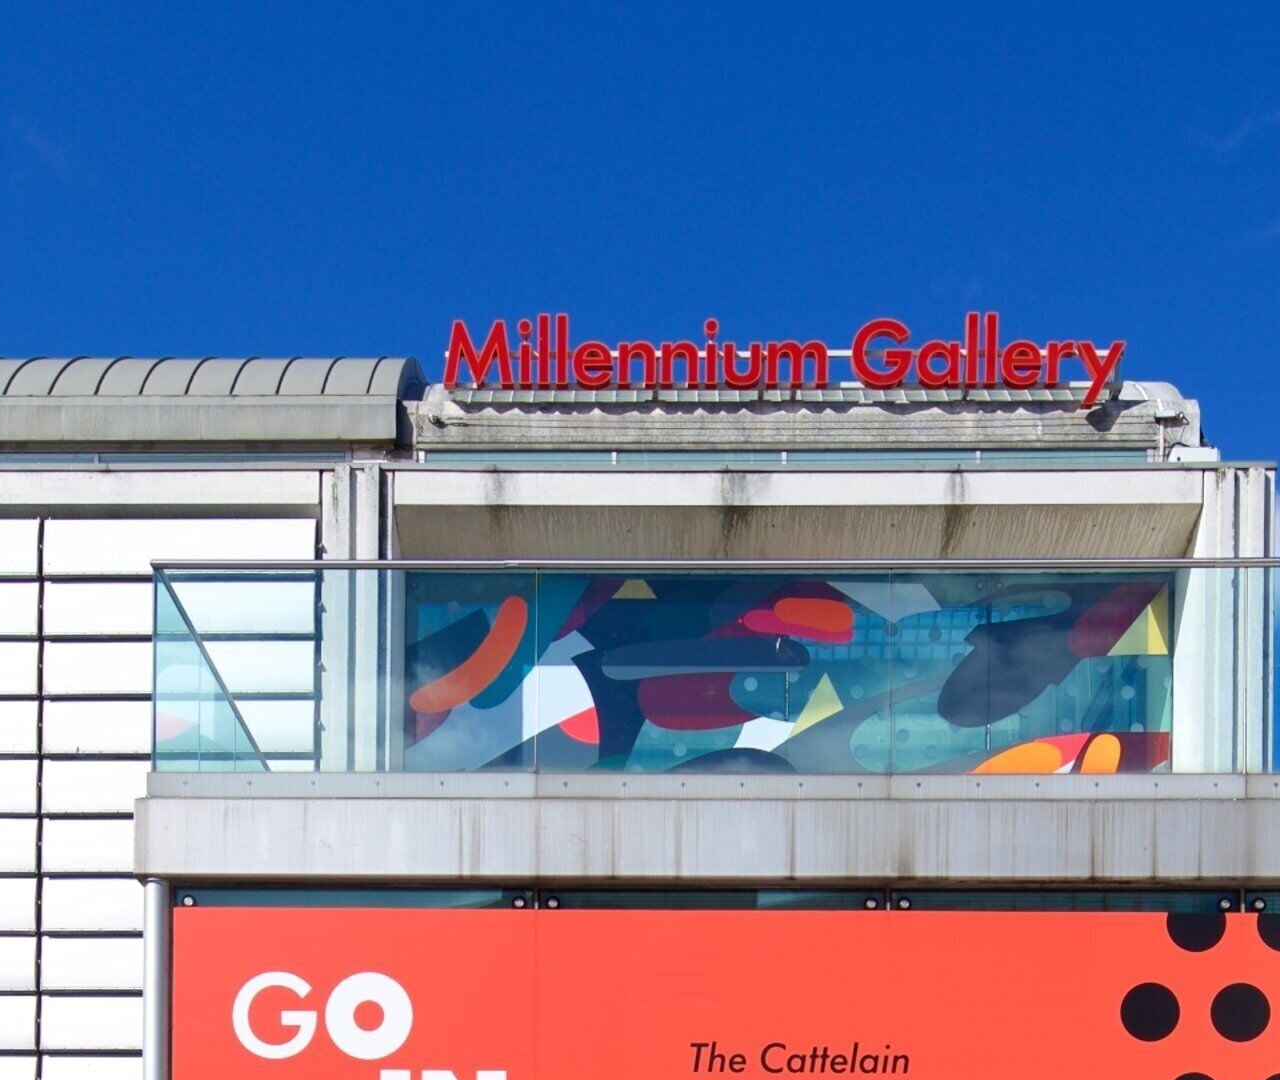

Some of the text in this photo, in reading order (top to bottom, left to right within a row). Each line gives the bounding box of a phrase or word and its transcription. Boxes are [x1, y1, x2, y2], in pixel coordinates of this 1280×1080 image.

[443, 312, 1125, 410] Millennium Gallery
[690, 1041, 910, 1074] The Cattelain
